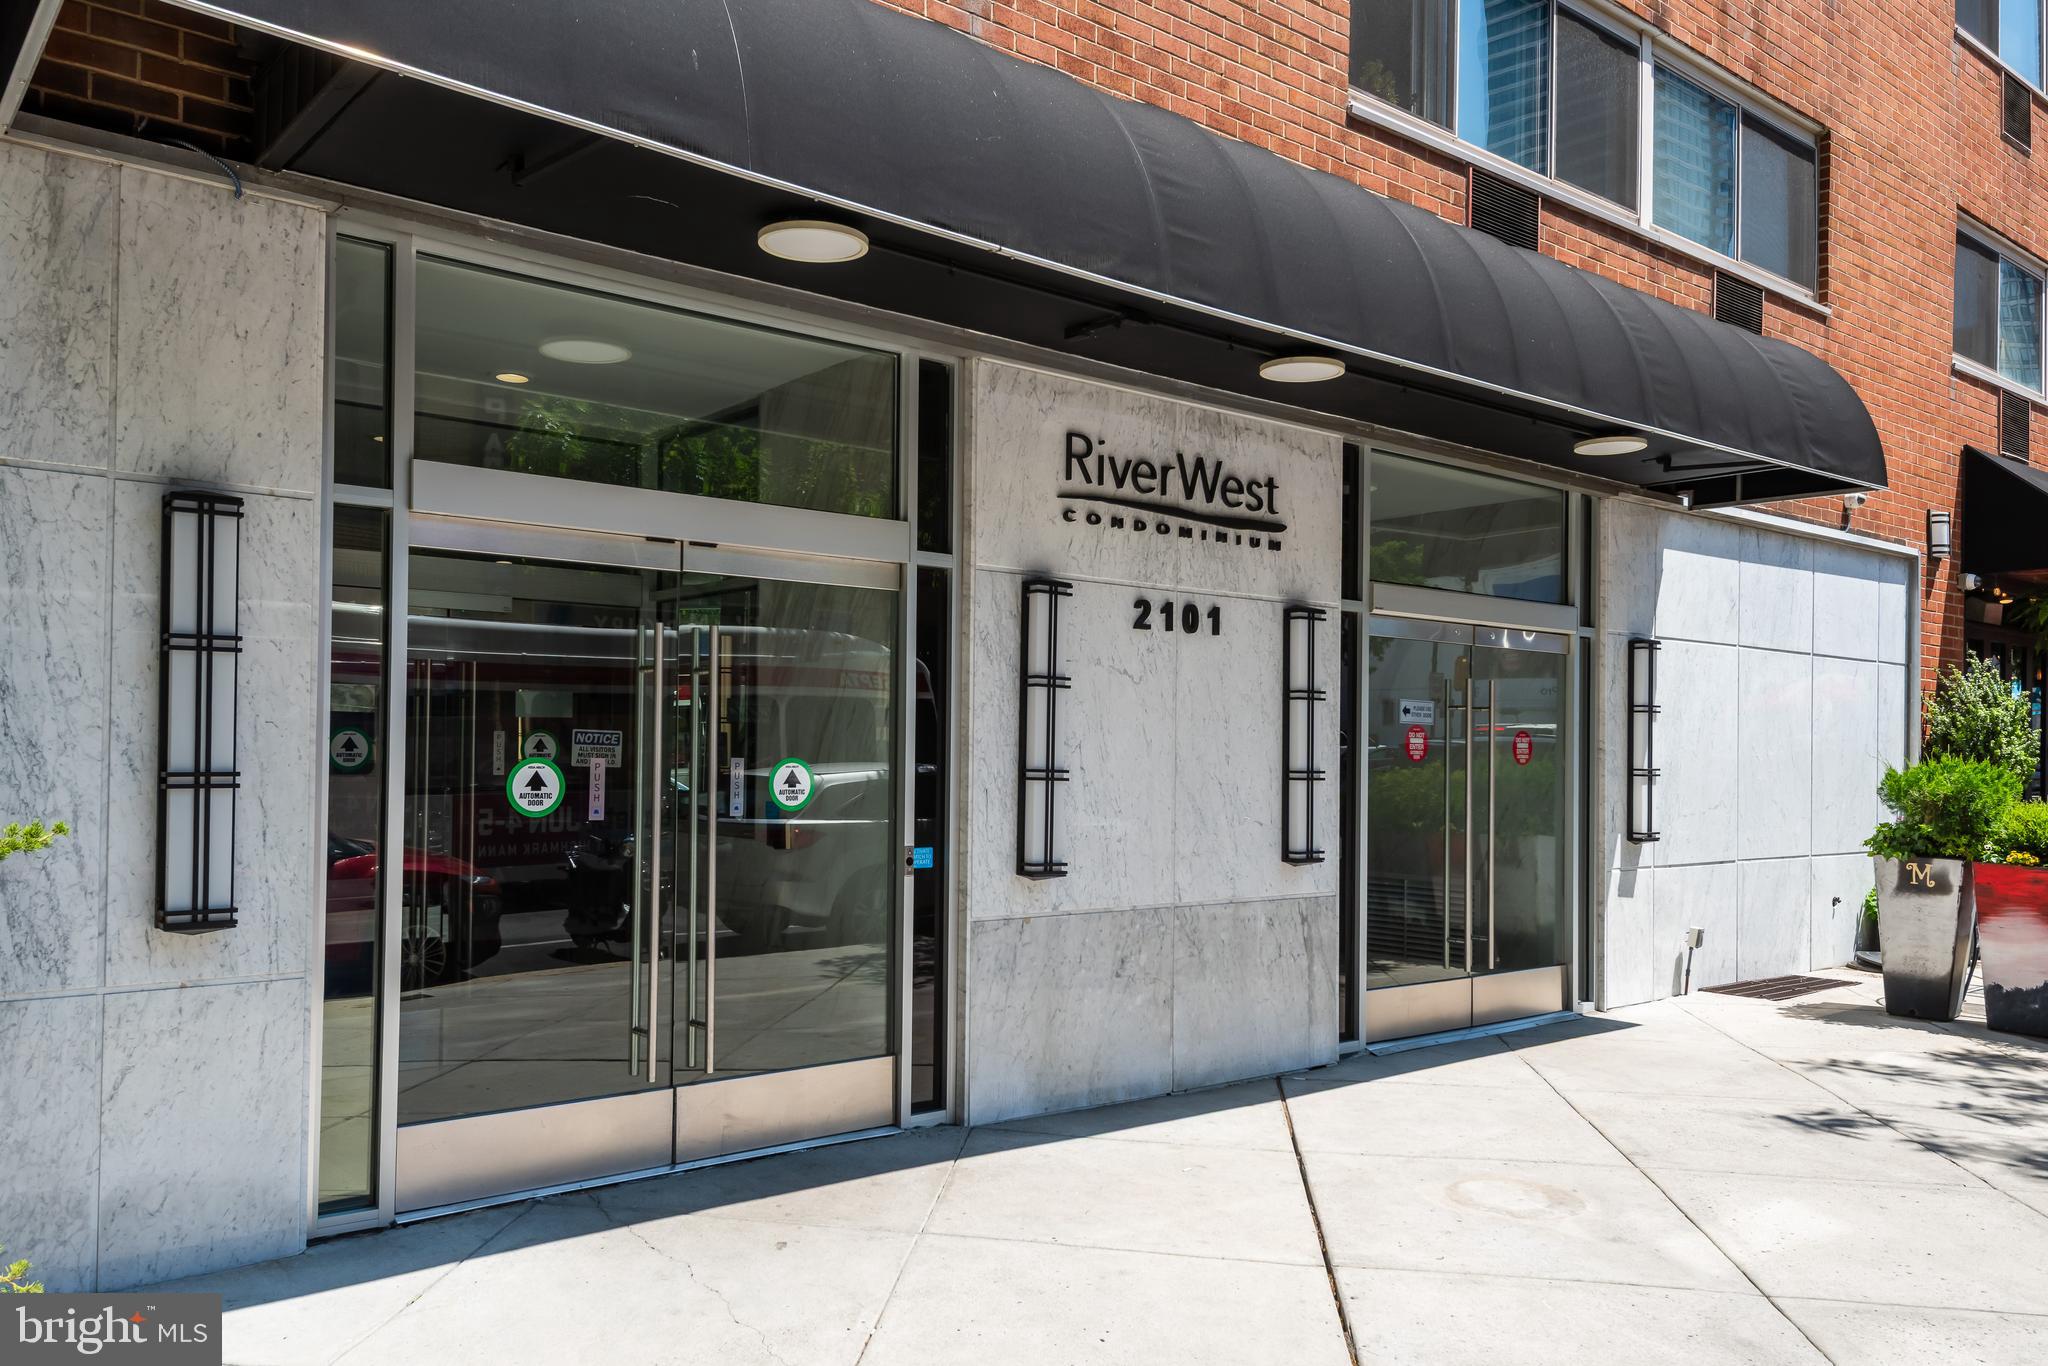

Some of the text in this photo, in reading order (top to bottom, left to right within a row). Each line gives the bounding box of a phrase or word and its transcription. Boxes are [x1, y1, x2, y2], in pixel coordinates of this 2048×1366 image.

[1065, 432, 1279, 515] RiverWest
[1062, 509, 1282, 551] CONDOMINIUM
[1132, 599, 1221, 636] 2101
[576, 733, 619, 744] NOTICE
[593, 763, 601, 802] PUSH
[1906, 862, 1936, 888] M
